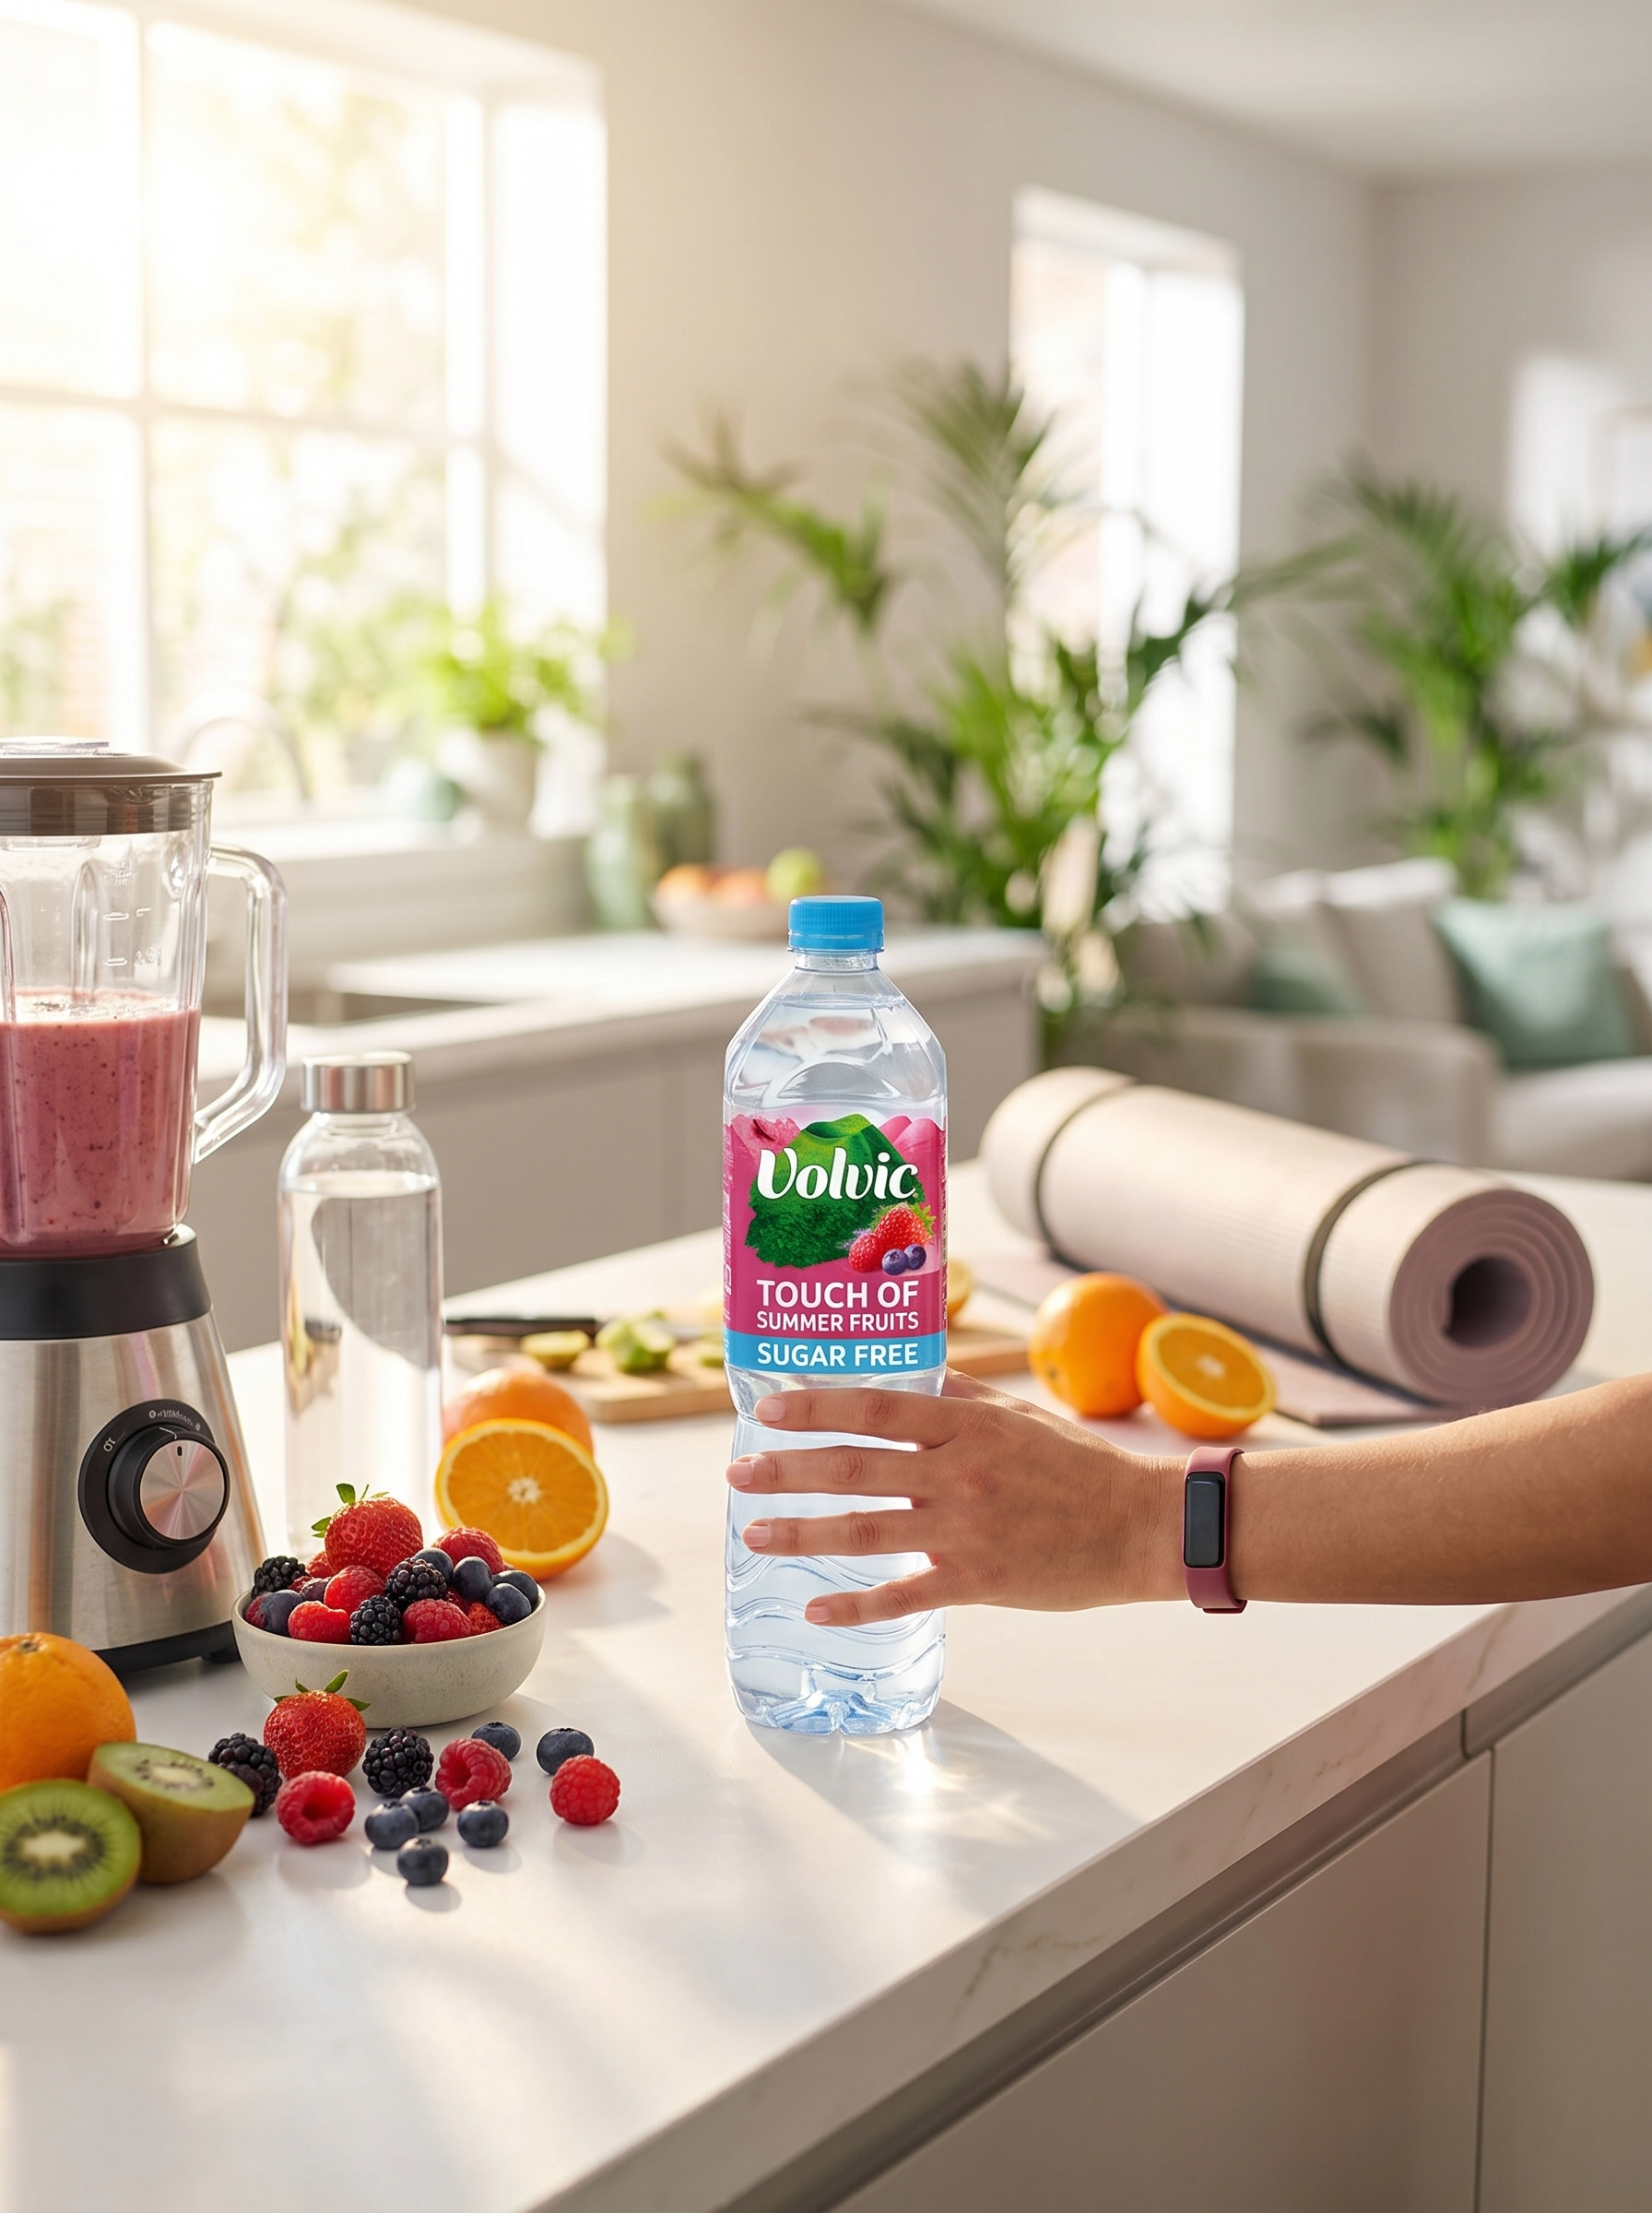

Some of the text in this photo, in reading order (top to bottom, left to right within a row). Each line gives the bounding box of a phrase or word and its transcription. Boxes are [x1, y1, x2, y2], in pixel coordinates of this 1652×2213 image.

[757, 1147, 918, 1200] Volvic
[756, 1279, 919, 1308] TOUCH OF
[756, 1310, 919, 1332] SUMMER FRUITS
[757, 1343, 919, 1367] SUGAR FREE
